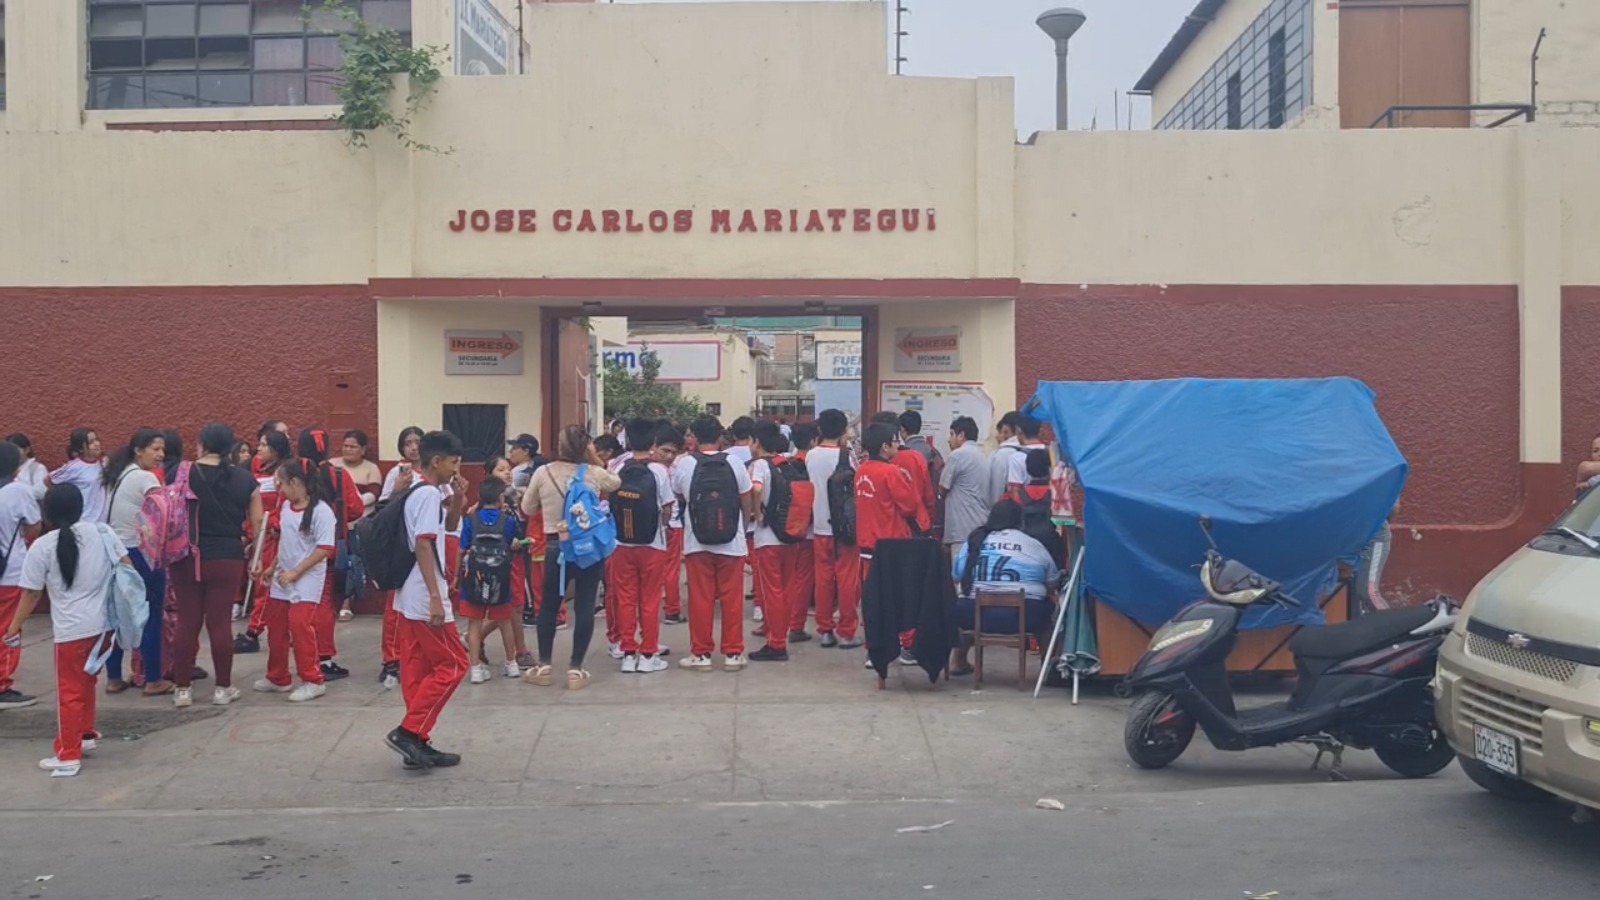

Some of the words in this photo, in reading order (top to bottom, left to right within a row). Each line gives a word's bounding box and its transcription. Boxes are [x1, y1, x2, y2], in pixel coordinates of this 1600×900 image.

[450, 209, 537, 232] JOSE
[552, 209, 693, 232] CARLOS
[710, 208, 937, 232] MARIATEGUI
[452, 340, 514, 350] INGRESO
[903, 339, 957, 348] INGRESO
[981, 542, 1022, 551] ESICA
[978, 555, 1021, 581] 16
